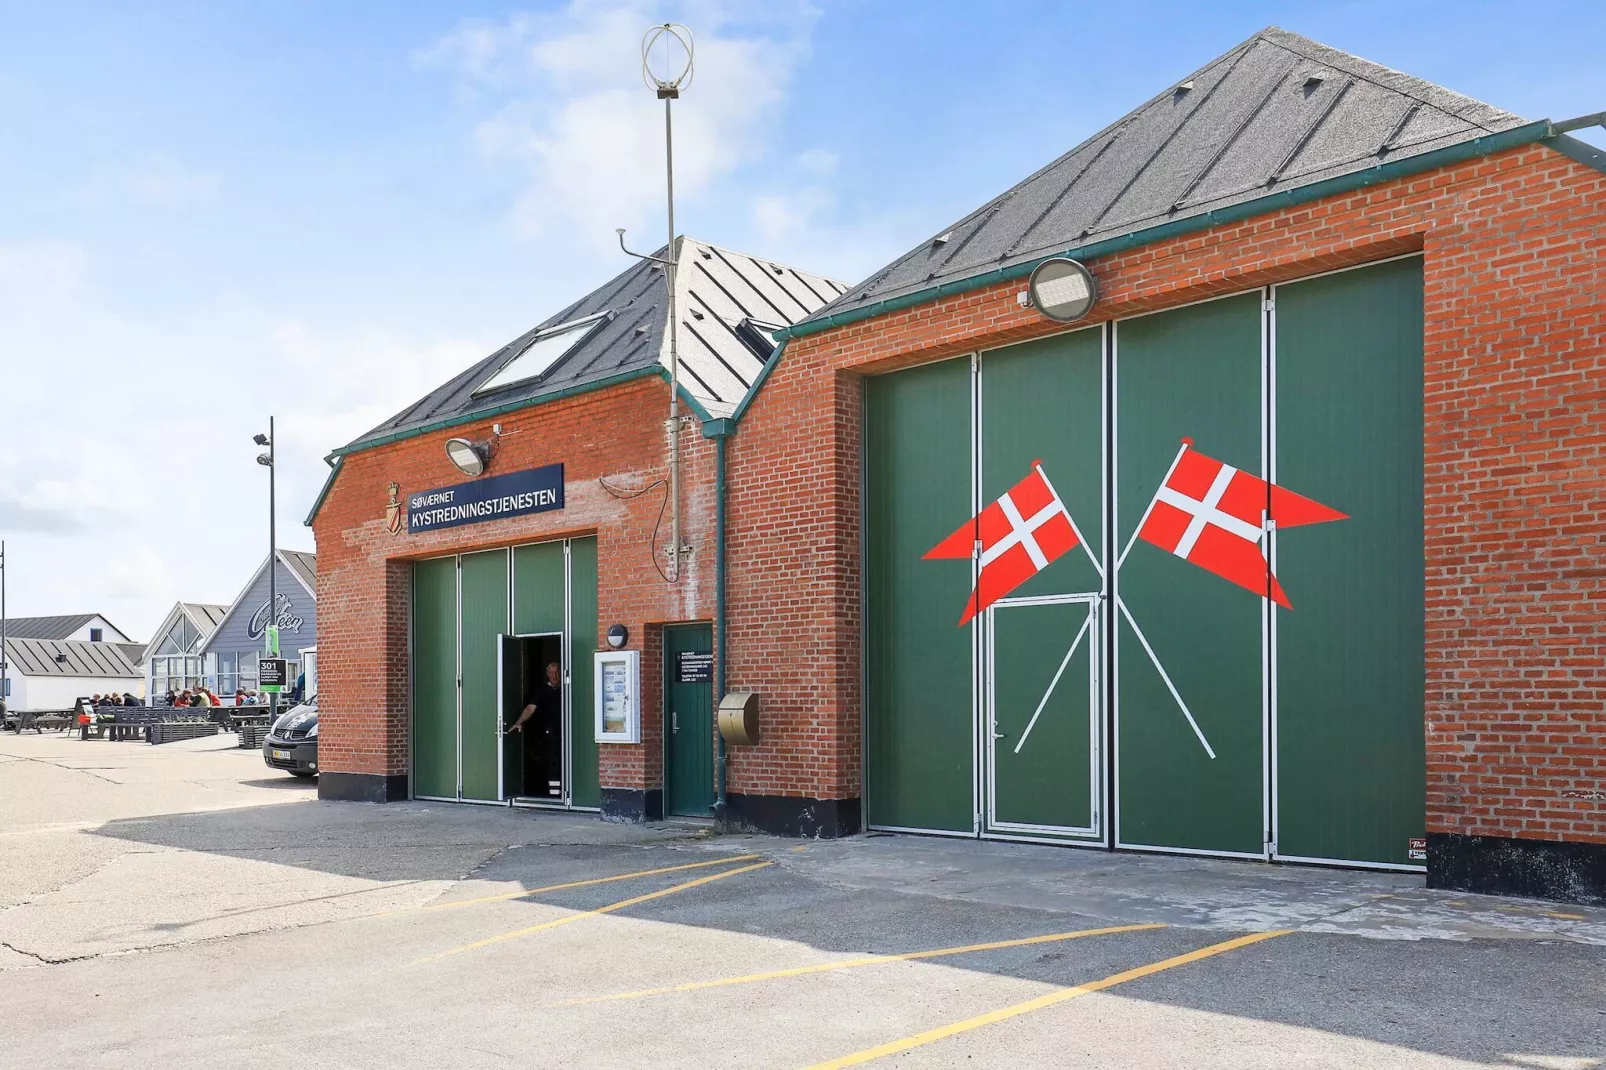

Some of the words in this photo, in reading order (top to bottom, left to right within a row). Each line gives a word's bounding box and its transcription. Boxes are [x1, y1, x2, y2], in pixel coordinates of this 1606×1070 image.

[411, 490, 455, 509] SØVÆRNET
[411, 487, 557, 528] KYSTREDNINGSTJENESTEN
[260, 662, 277, 670] 301
